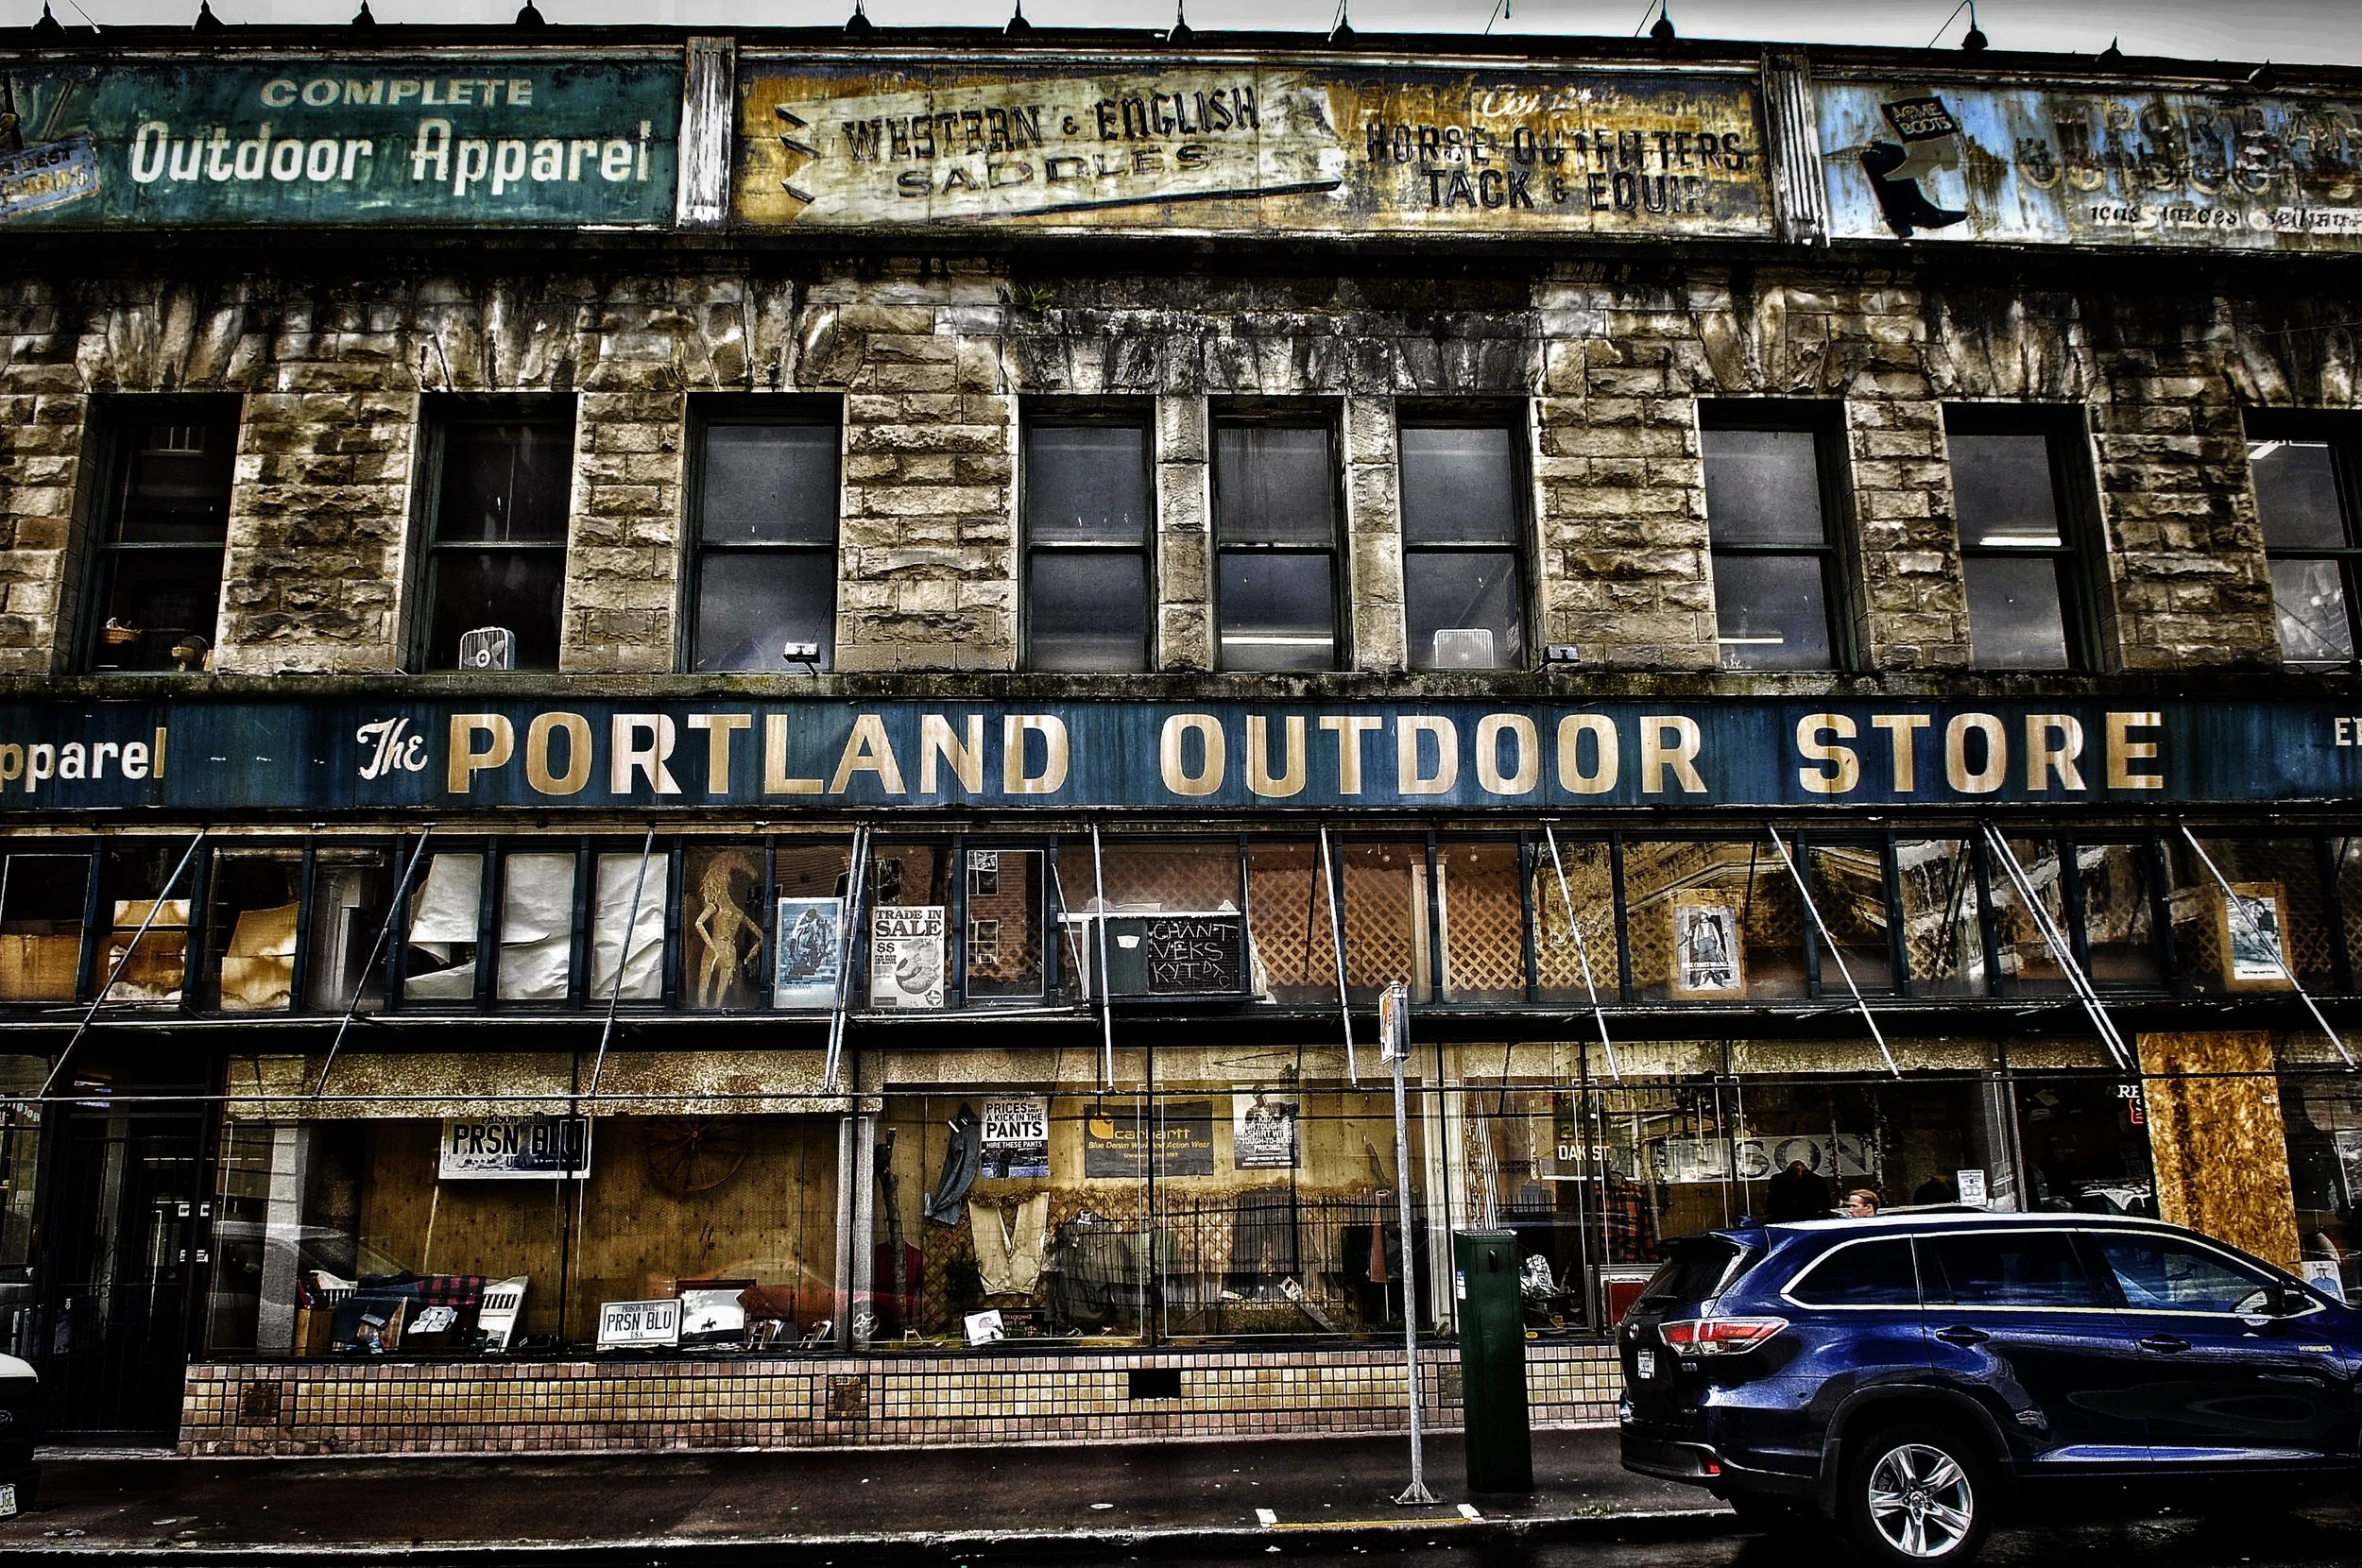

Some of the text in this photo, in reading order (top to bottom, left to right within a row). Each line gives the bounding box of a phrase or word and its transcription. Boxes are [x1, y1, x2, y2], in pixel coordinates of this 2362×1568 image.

[260, 78, 534, 107] COMPLETE
[842, 85, 1262, 163] WESTERN & ENGLISH
[1899, 116, 1952, 134] BOOTS
[129, 119, 373, 184] Outdoor
[1365, 123, 1747, 172] HORSE OUTFITTERS
[899, 144, 1212, 197] SADDLES
[1421, 168, 1535, 210] TACK
[1551, 179, 1570, 204] &
[356, 711, 2165, 797] The PORTLAND OUTDOOR STORE
[875, 910, 943, 920] TRADE IN
[875, 920, 943, 937] SALE
[986, 1102, 1027, 1114] PRICES
[986, 1114, 993, 1122] A
[994, 1114, 1015, 1122] KICK
[1026, 1113, 1043, 1121] THE
[453, 1124, 520, 1154] PRSN
[986, 1121, 1043, 1138] PANTS
[607, 1311, 673, 1332] PRSN BLU
